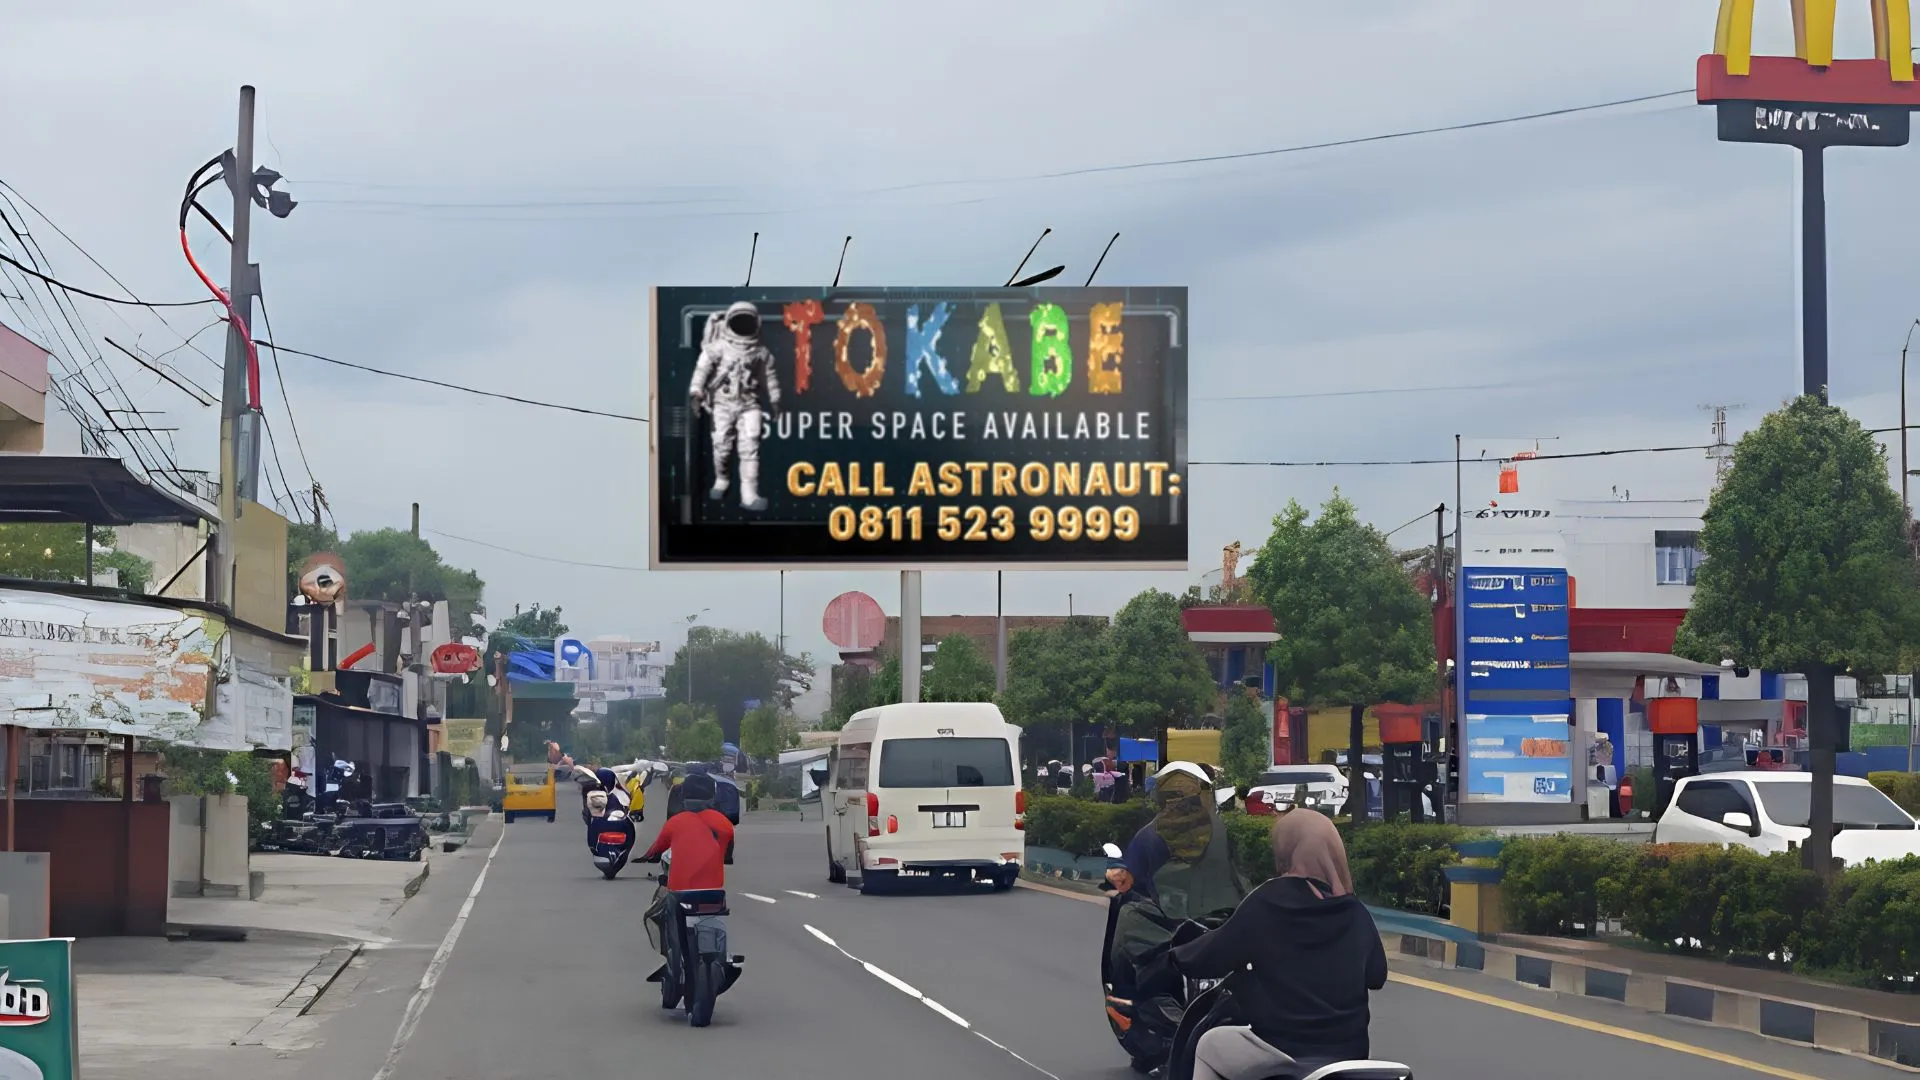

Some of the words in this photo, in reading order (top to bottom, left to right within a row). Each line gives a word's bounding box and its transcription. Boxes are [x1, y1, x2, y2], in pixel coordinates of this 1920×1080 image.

[783, 298, 1125, 398] TOKABE
[871, 411, 967, 440] SPACE
[983, 411, 1151, 440] AVAILABLE
[786, 461, 895, 497] CALL
[907, 461, 1182, 497] ASTRONAUT:
[828, 505, 922, 542] 0811
[937, 505, 1016, 541] 523
[1028, 505, 1140, 541] 9999
